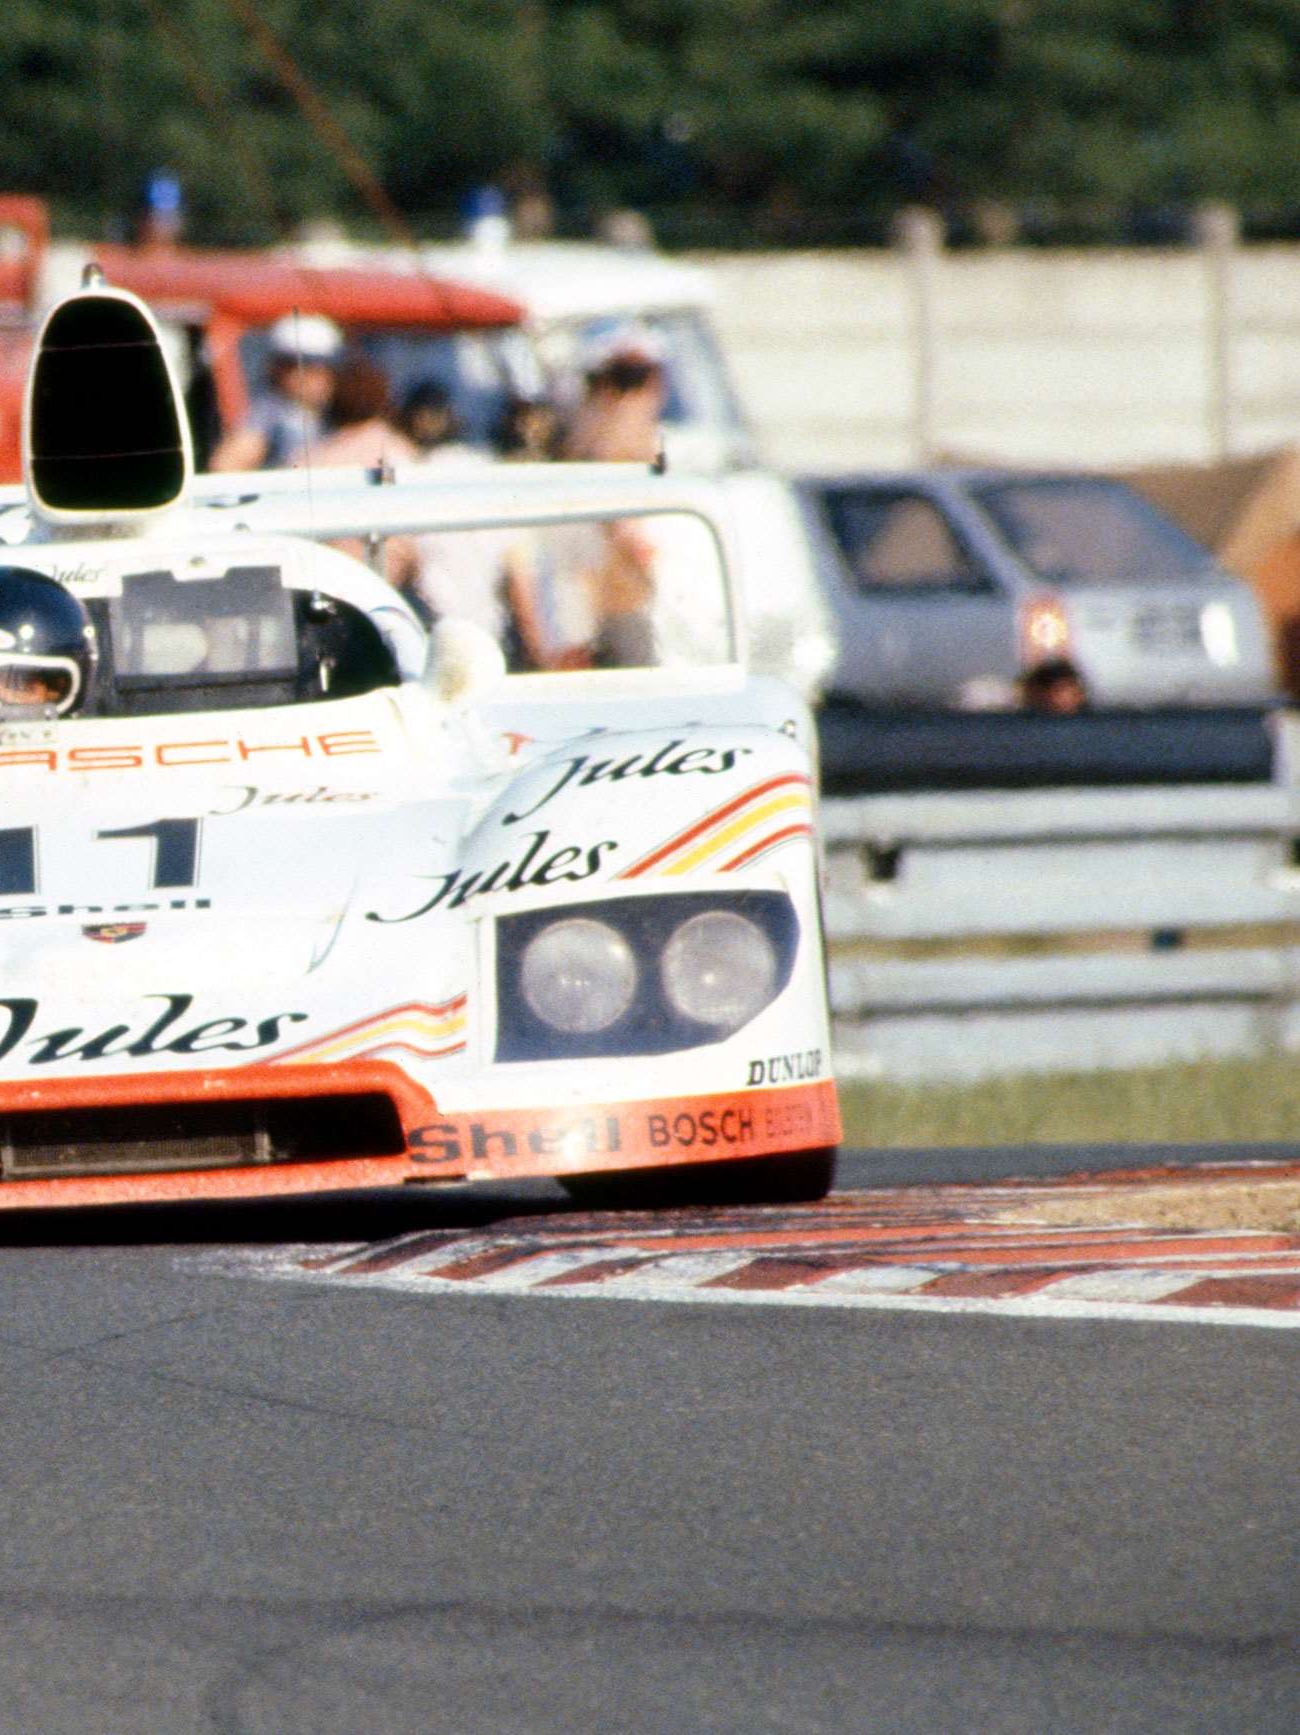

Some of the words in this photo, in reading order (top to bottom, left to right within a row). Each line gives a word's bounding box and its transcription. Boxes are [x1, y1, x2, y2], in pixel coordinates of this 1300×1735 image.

[501, 739, 753, 826] Jules
[365, 830, 618, 922] Jules
[747, 1050, 821, 1086] DUNLOP
[407, 1117, 621, 1163] Shell
[649, 1109, 755, 1147] BOSCH
